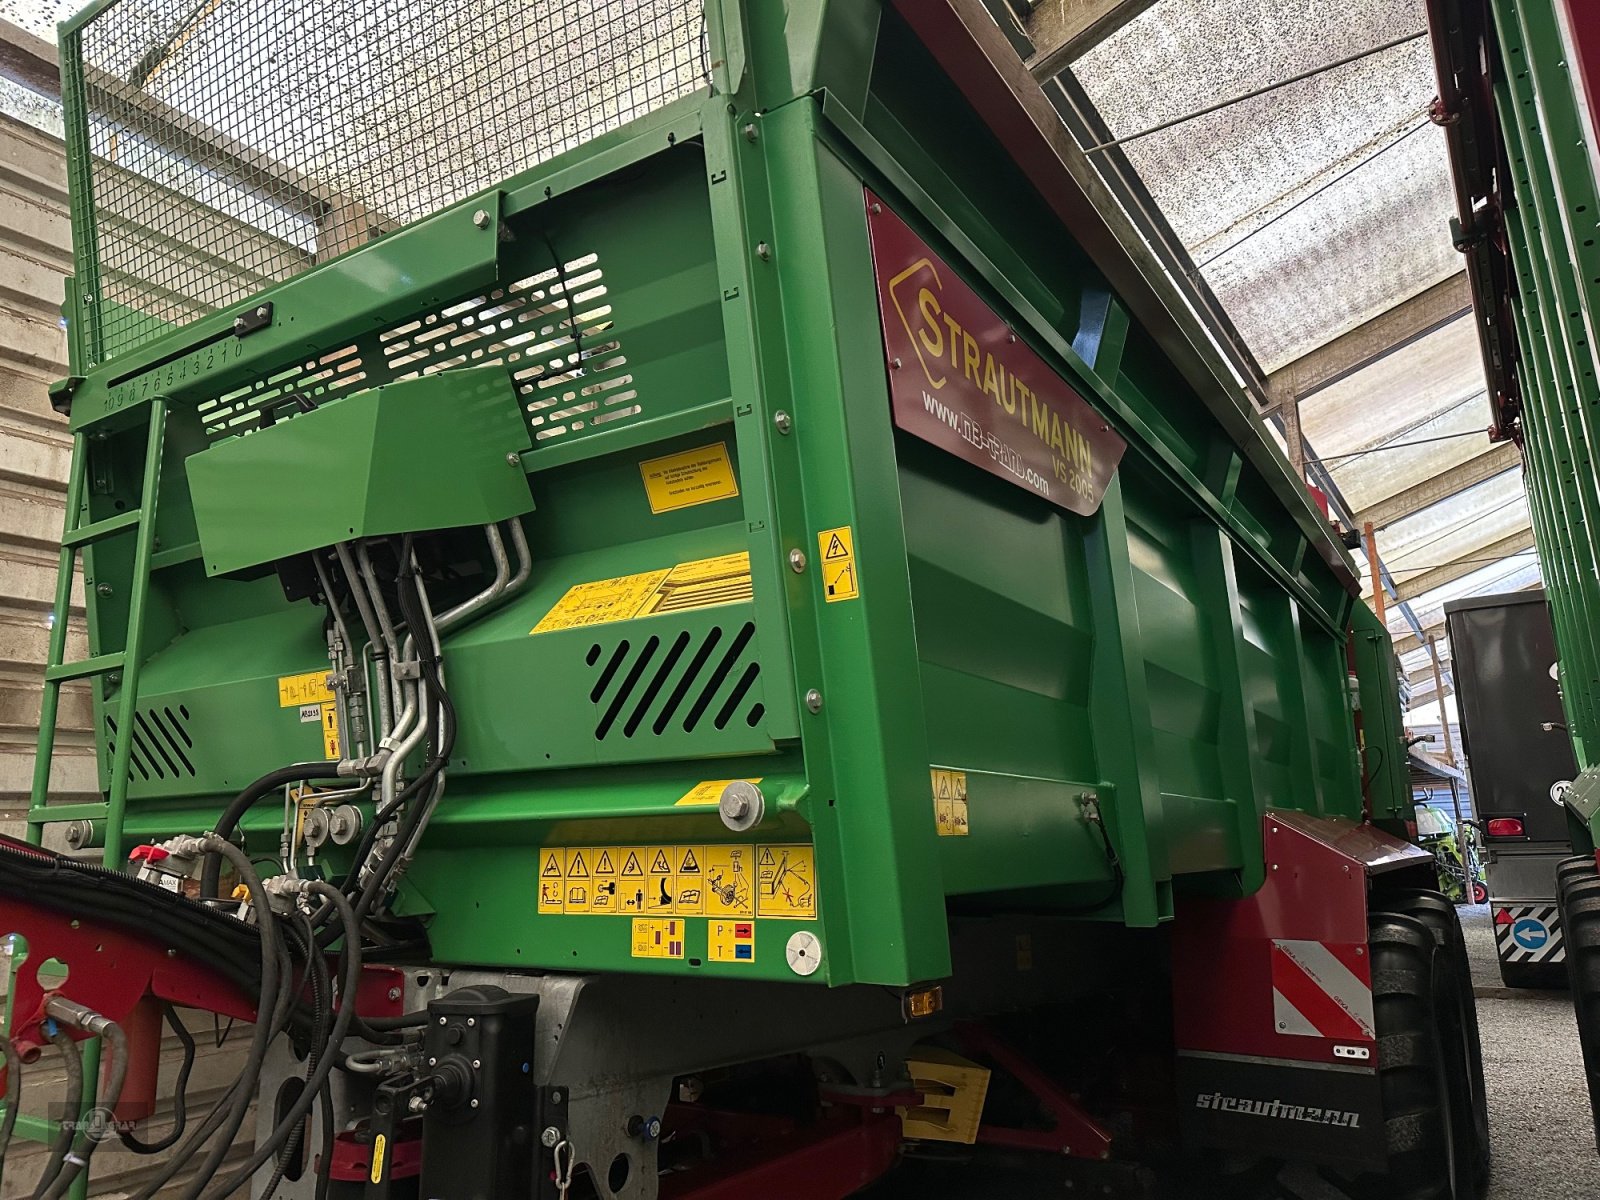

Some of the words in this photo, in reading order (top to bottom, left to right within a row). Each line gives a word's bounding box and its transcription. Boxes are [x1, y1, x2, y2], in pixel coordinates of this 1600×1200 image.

[142, 382, 149, 396] 7
[154, 377, 161, 391] 6
[166, 372, 174, 386] 5
[193, 361, 200, 375] 3
[206, 355, 214, 370] 2
[235, 343, 242, 358] 0
[918, 287, 1093, 478] STRAUTMANN
[1051, 454, 1069, 485] VS
[1069, 470, 1094, 502] 2005
[717, 925, 724, 937] P
[717, 945, 723, 957] T
[1195, 1091, 1360, 1128] strautmann
